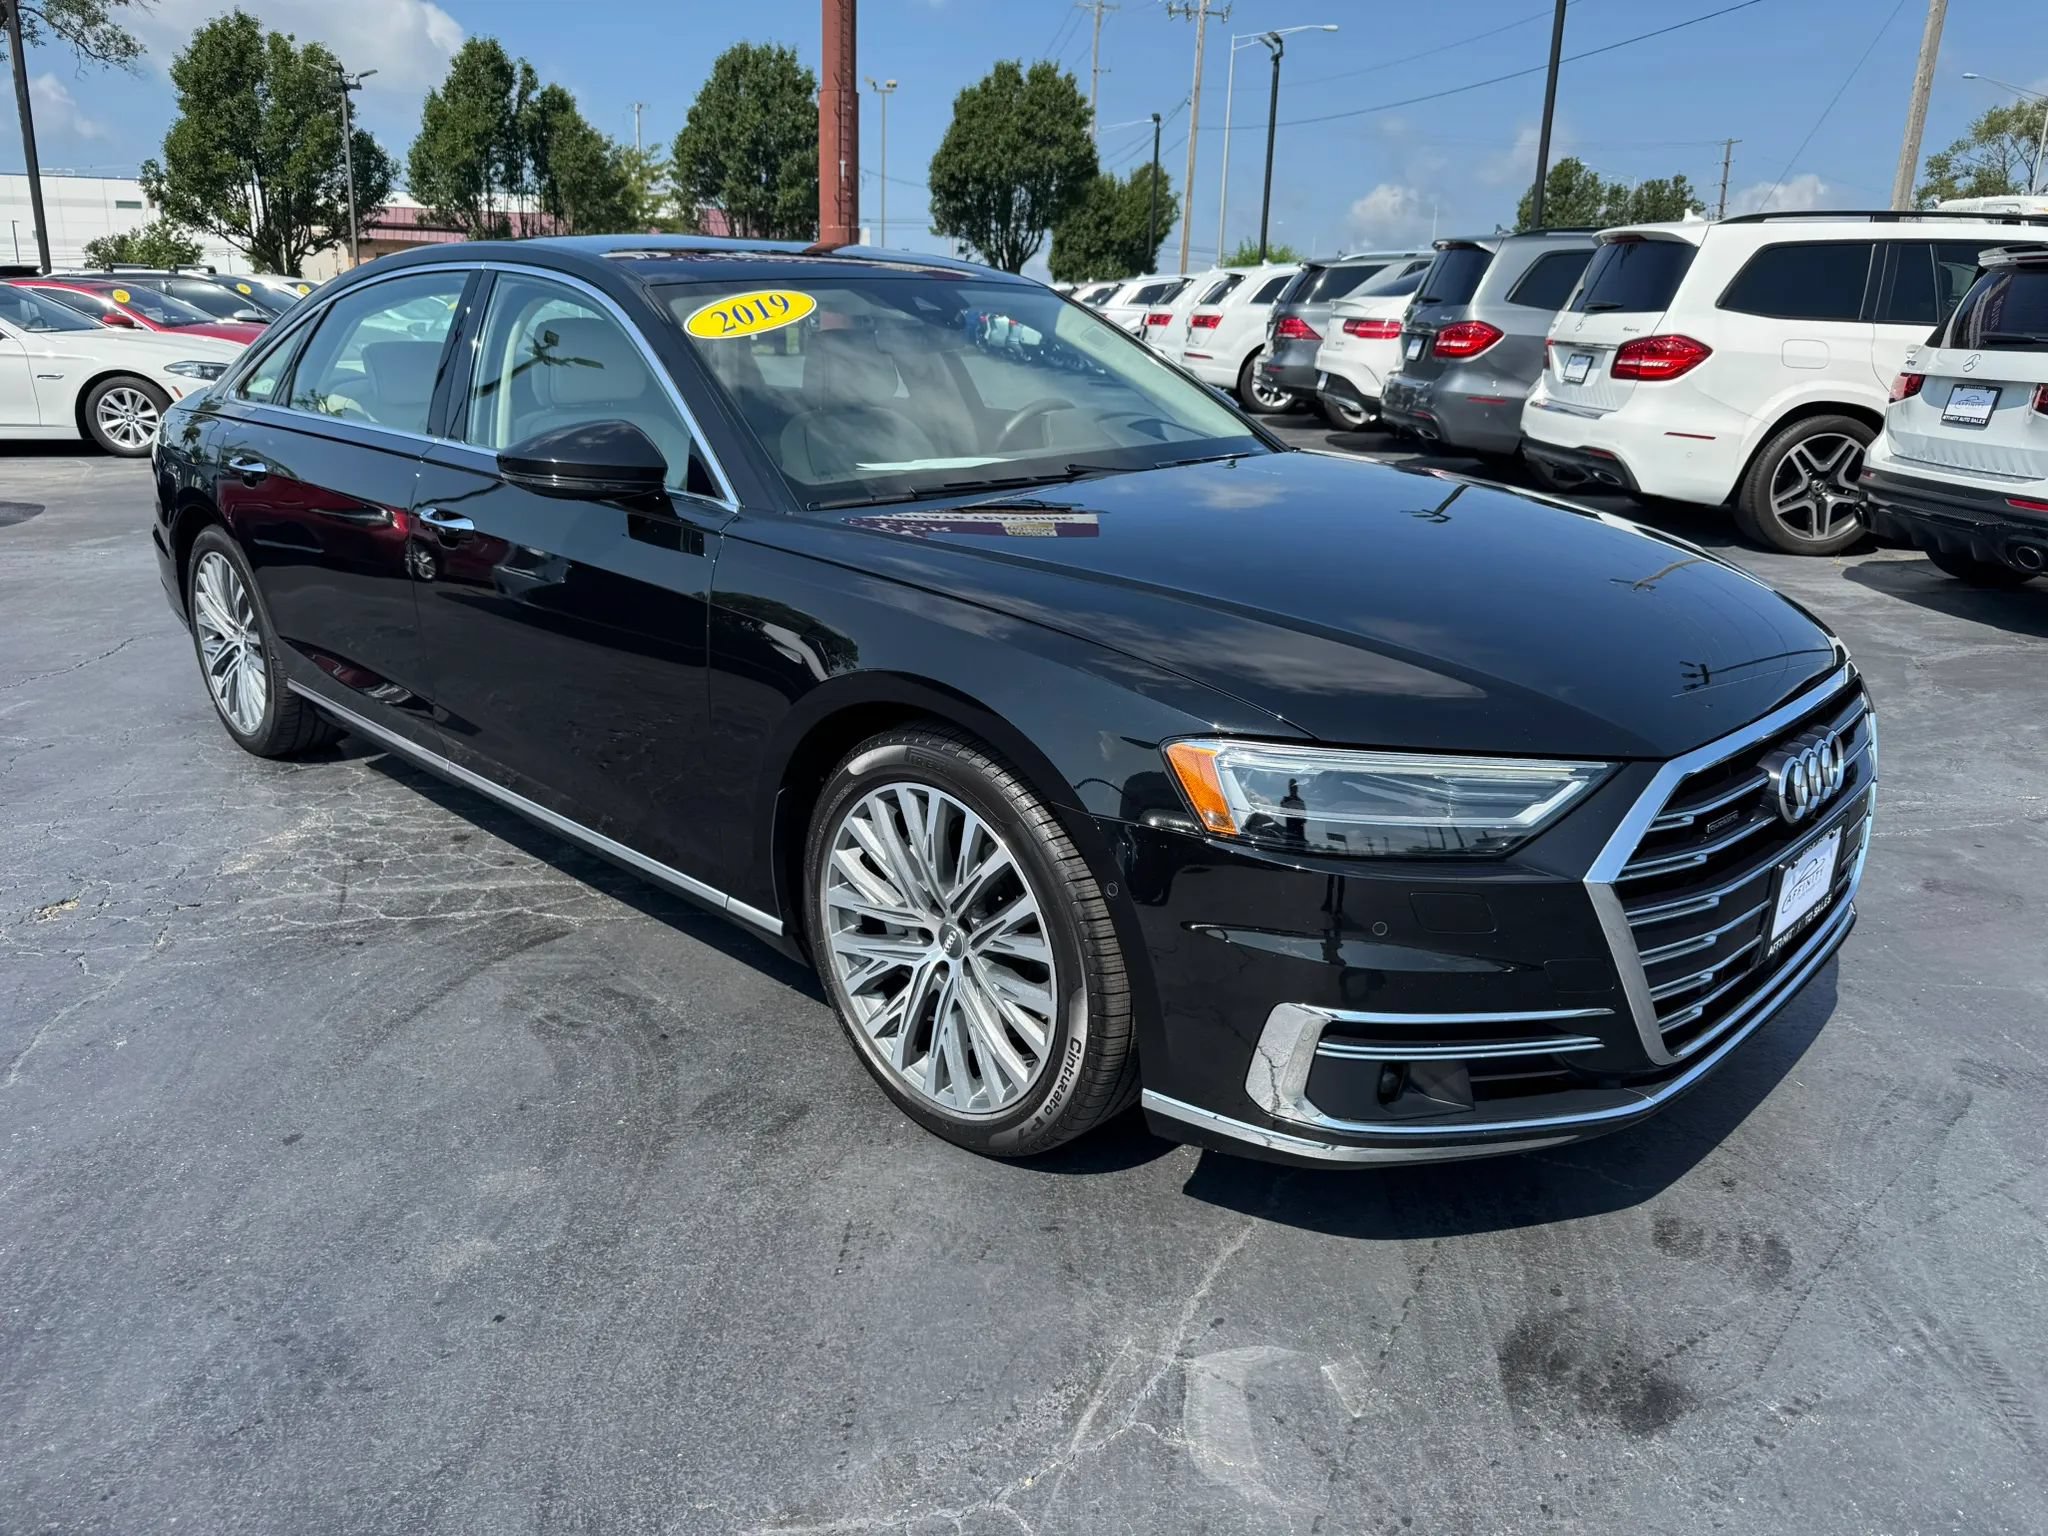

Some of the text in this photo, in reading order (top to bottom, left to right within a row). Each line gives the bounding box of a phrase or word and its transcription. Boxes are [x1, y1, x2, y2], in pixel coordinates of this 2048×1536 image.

[710, 294, 790, 334] 2019
[1786, 869, 1823, 904] AFFINITY
[1813, 894, 1832, 917] SALES
